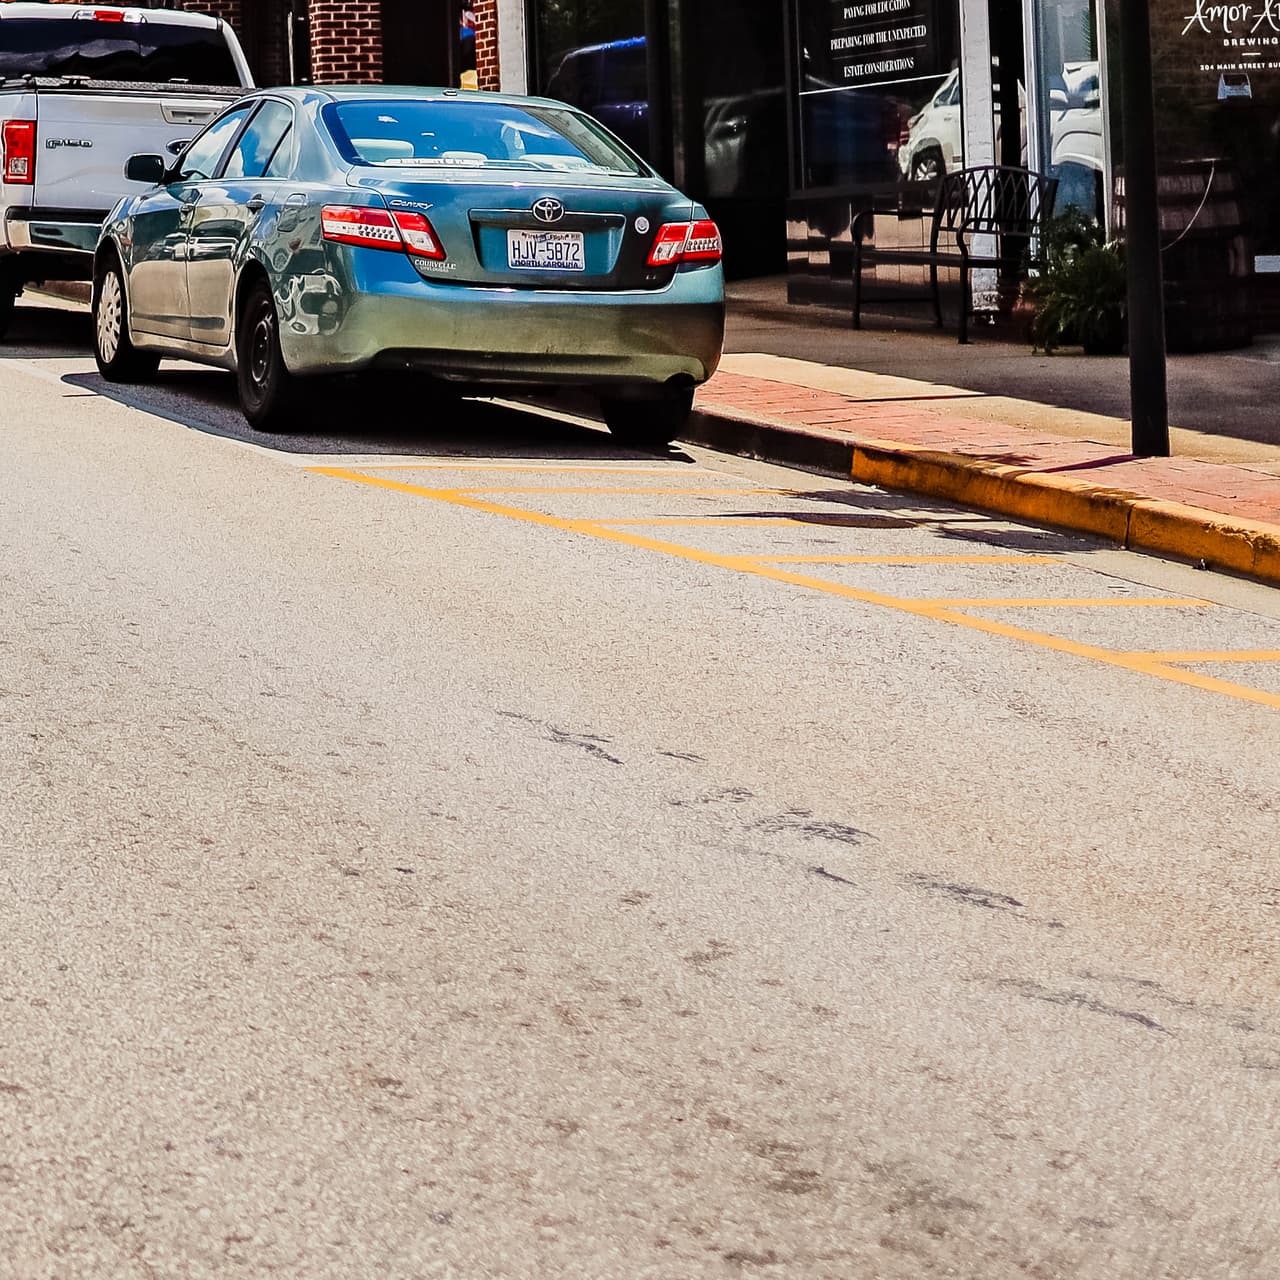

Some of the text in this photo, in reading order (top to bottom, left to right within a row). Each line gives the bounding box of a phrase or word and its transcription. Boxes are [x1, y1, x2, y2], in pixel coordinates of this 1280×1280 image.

[843, 5, 865, 20] PAYING
[865, 2, 877, 16] FOR
[830, 24, 927, 51] PREPARING FOR THE UNEXPECTED
[1223, 36, 1279, 47] BREWING
[843, 56, 915, 78] ESTATE CONSIDERATIONS
[1238, 62, 1266, 70] STREET
[512, 240, 581, 261] HJV-5872
[514, 260, 578, 269] NORTH CAROLINA
